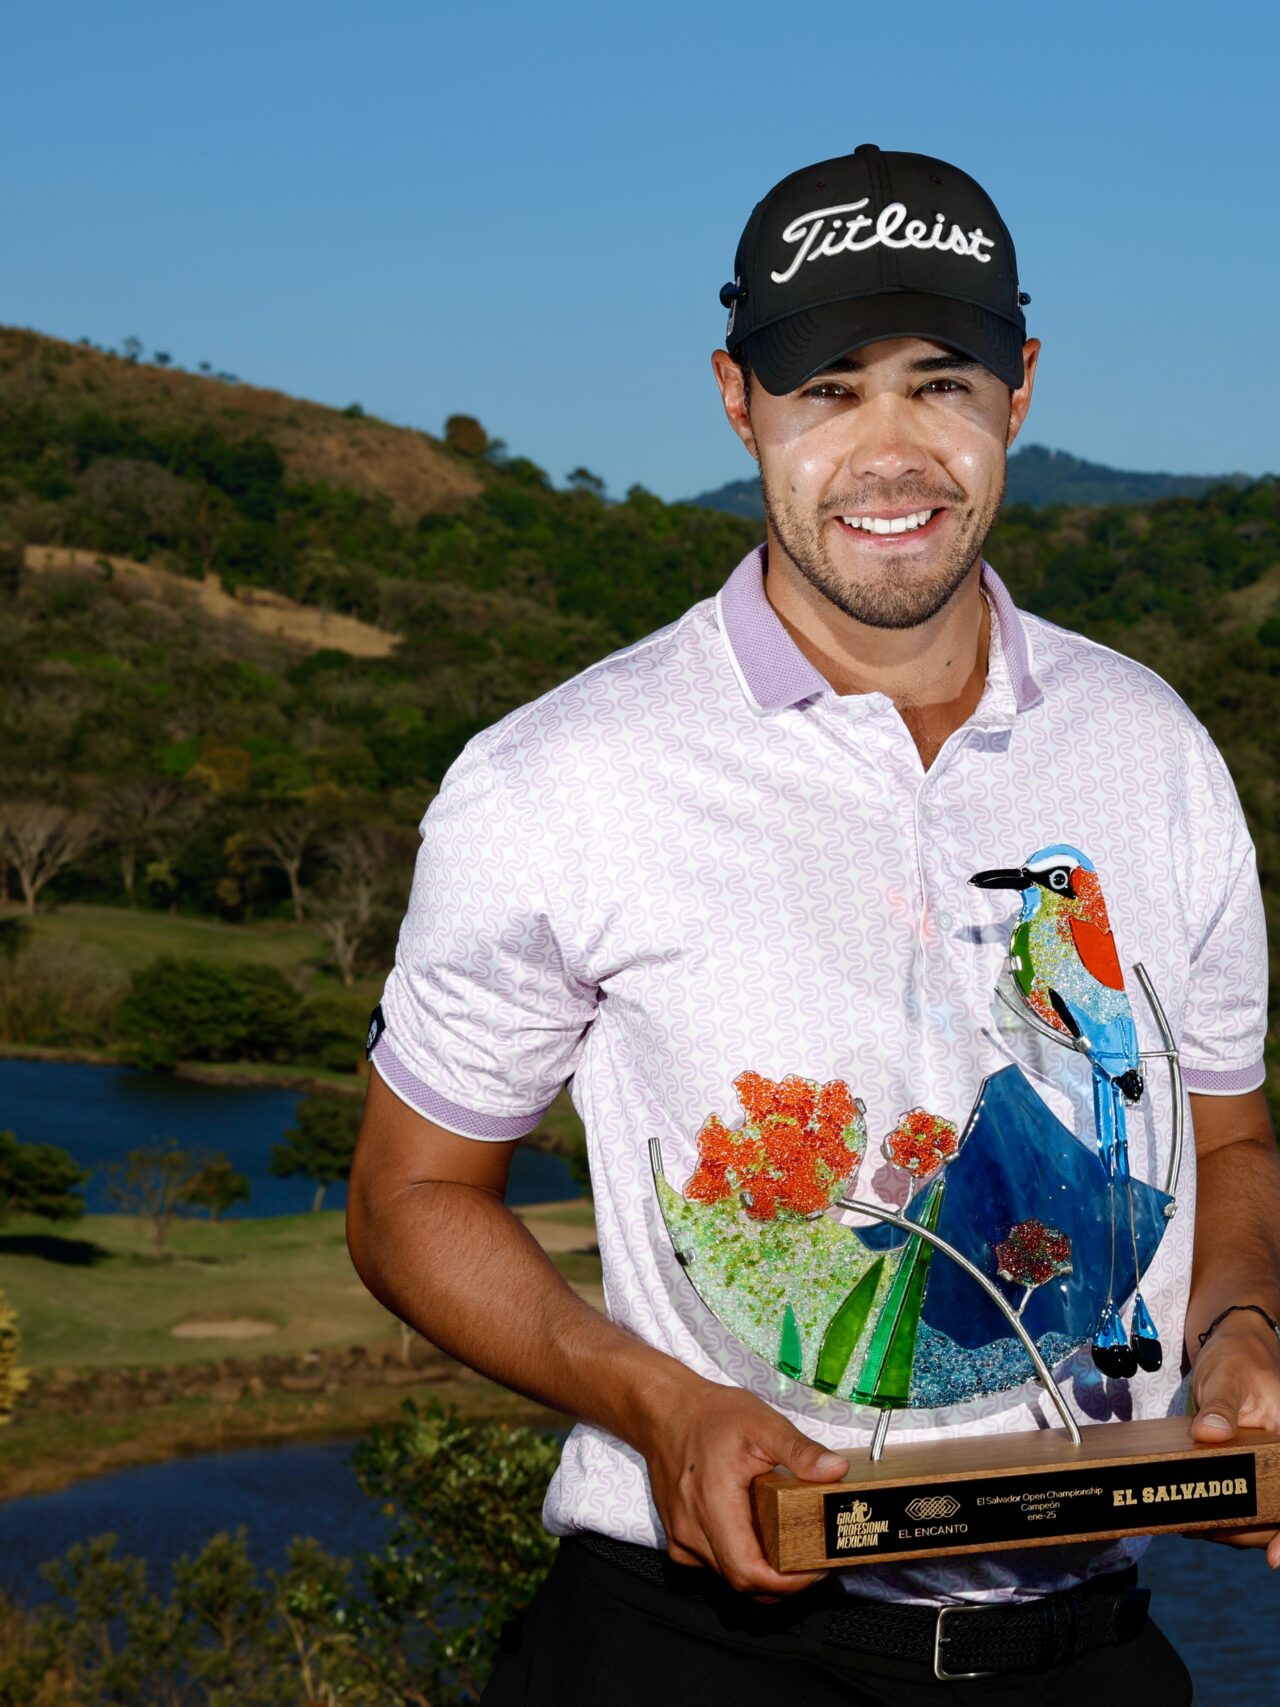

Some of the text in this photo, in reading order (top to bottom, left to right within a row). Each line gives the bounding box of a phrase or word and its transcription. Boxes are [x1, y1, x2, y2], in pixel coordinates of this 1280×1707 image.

[770, 196, 996, 285] Titleist
[976, 1486, 1104, 1506] El Salvador Open Championship
[1112, 1477, 1248, 1507] EL SALVADOR
[1020, 1500, 1061, 1512] Campeón
[836, 1511, 858, 1526] GIRA
[1027, 1510, 1057, 1521] ene-25
[837, 1520, 890, 1537] PROFESIONAL
[898, 1523, 969, 1539] EL ENCANTO
[836, 1533, 879, 1550] MEXICANA
